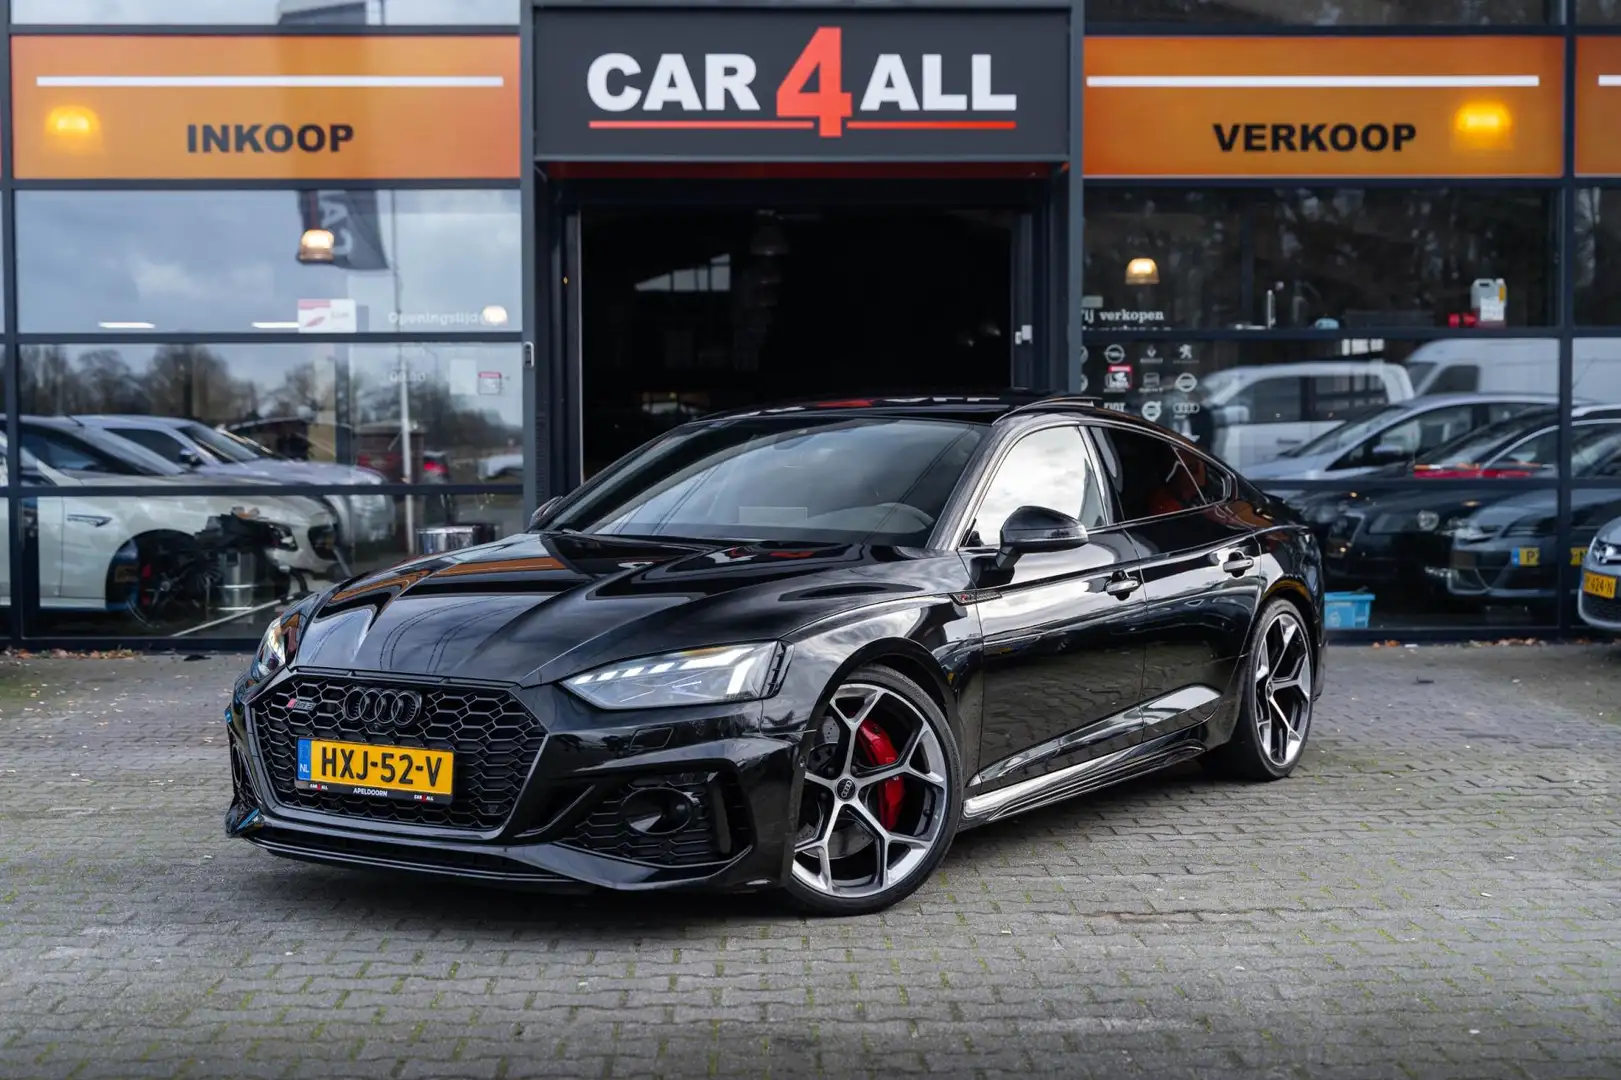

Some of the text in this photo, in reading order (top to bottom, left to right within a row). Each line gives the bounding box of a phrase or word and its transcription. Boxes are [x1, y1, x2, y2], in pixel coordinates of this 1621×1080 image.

[187, 123, 354, 154] INKOOP
[1213, 123, 1417, 153] VERKOOP
[1099, 308, 1164, 324] verkopen
[299, 746, 442, 788] NL HXJ-52-V
[353, 787, 388, 797] APELDOORN
